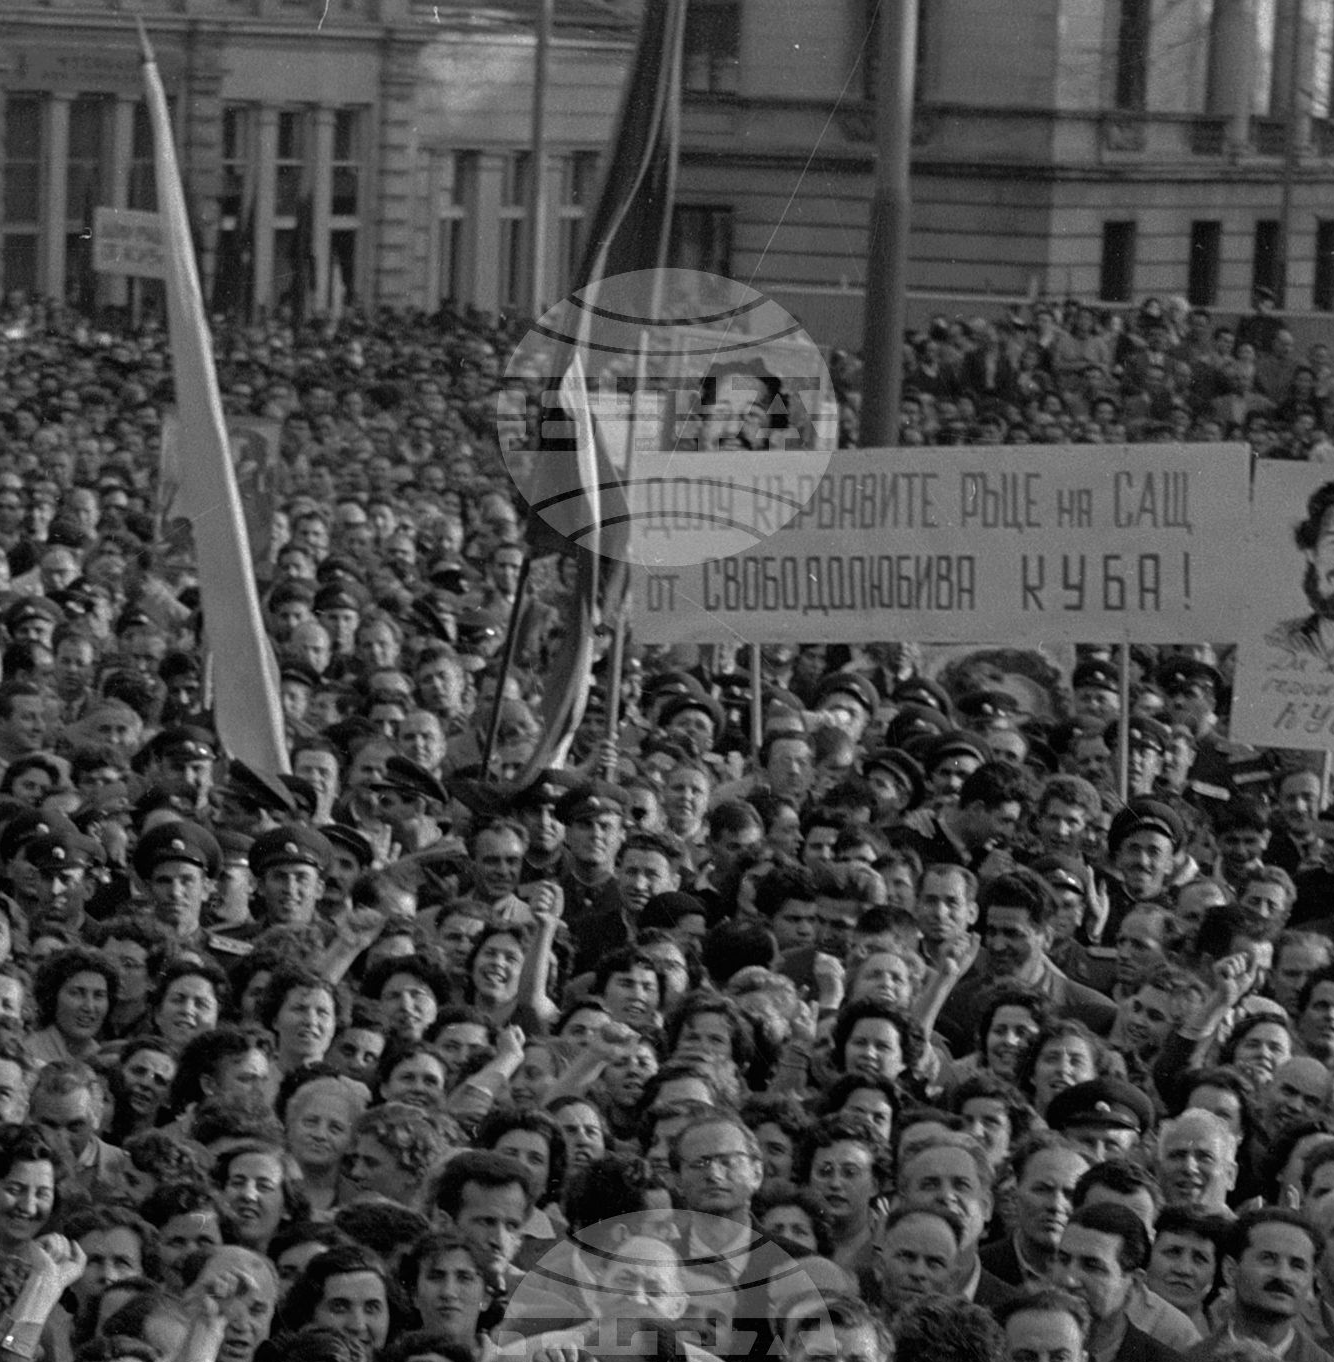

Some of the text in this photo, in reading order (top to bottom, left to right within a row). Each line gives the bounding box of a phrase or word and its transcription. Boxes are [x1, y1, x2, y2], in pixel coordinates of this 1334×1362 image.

[642, 475, 734, 539] ДОЛУ
[752, 472, 939, 531] КЪРВАВИТЕ
[961, 471, 1042, 534] РЪЦЕ
[1114, 471, 1193, 535] САЩ
[702, 555, 976, 616] СВОБОДОЛЮБИВА
